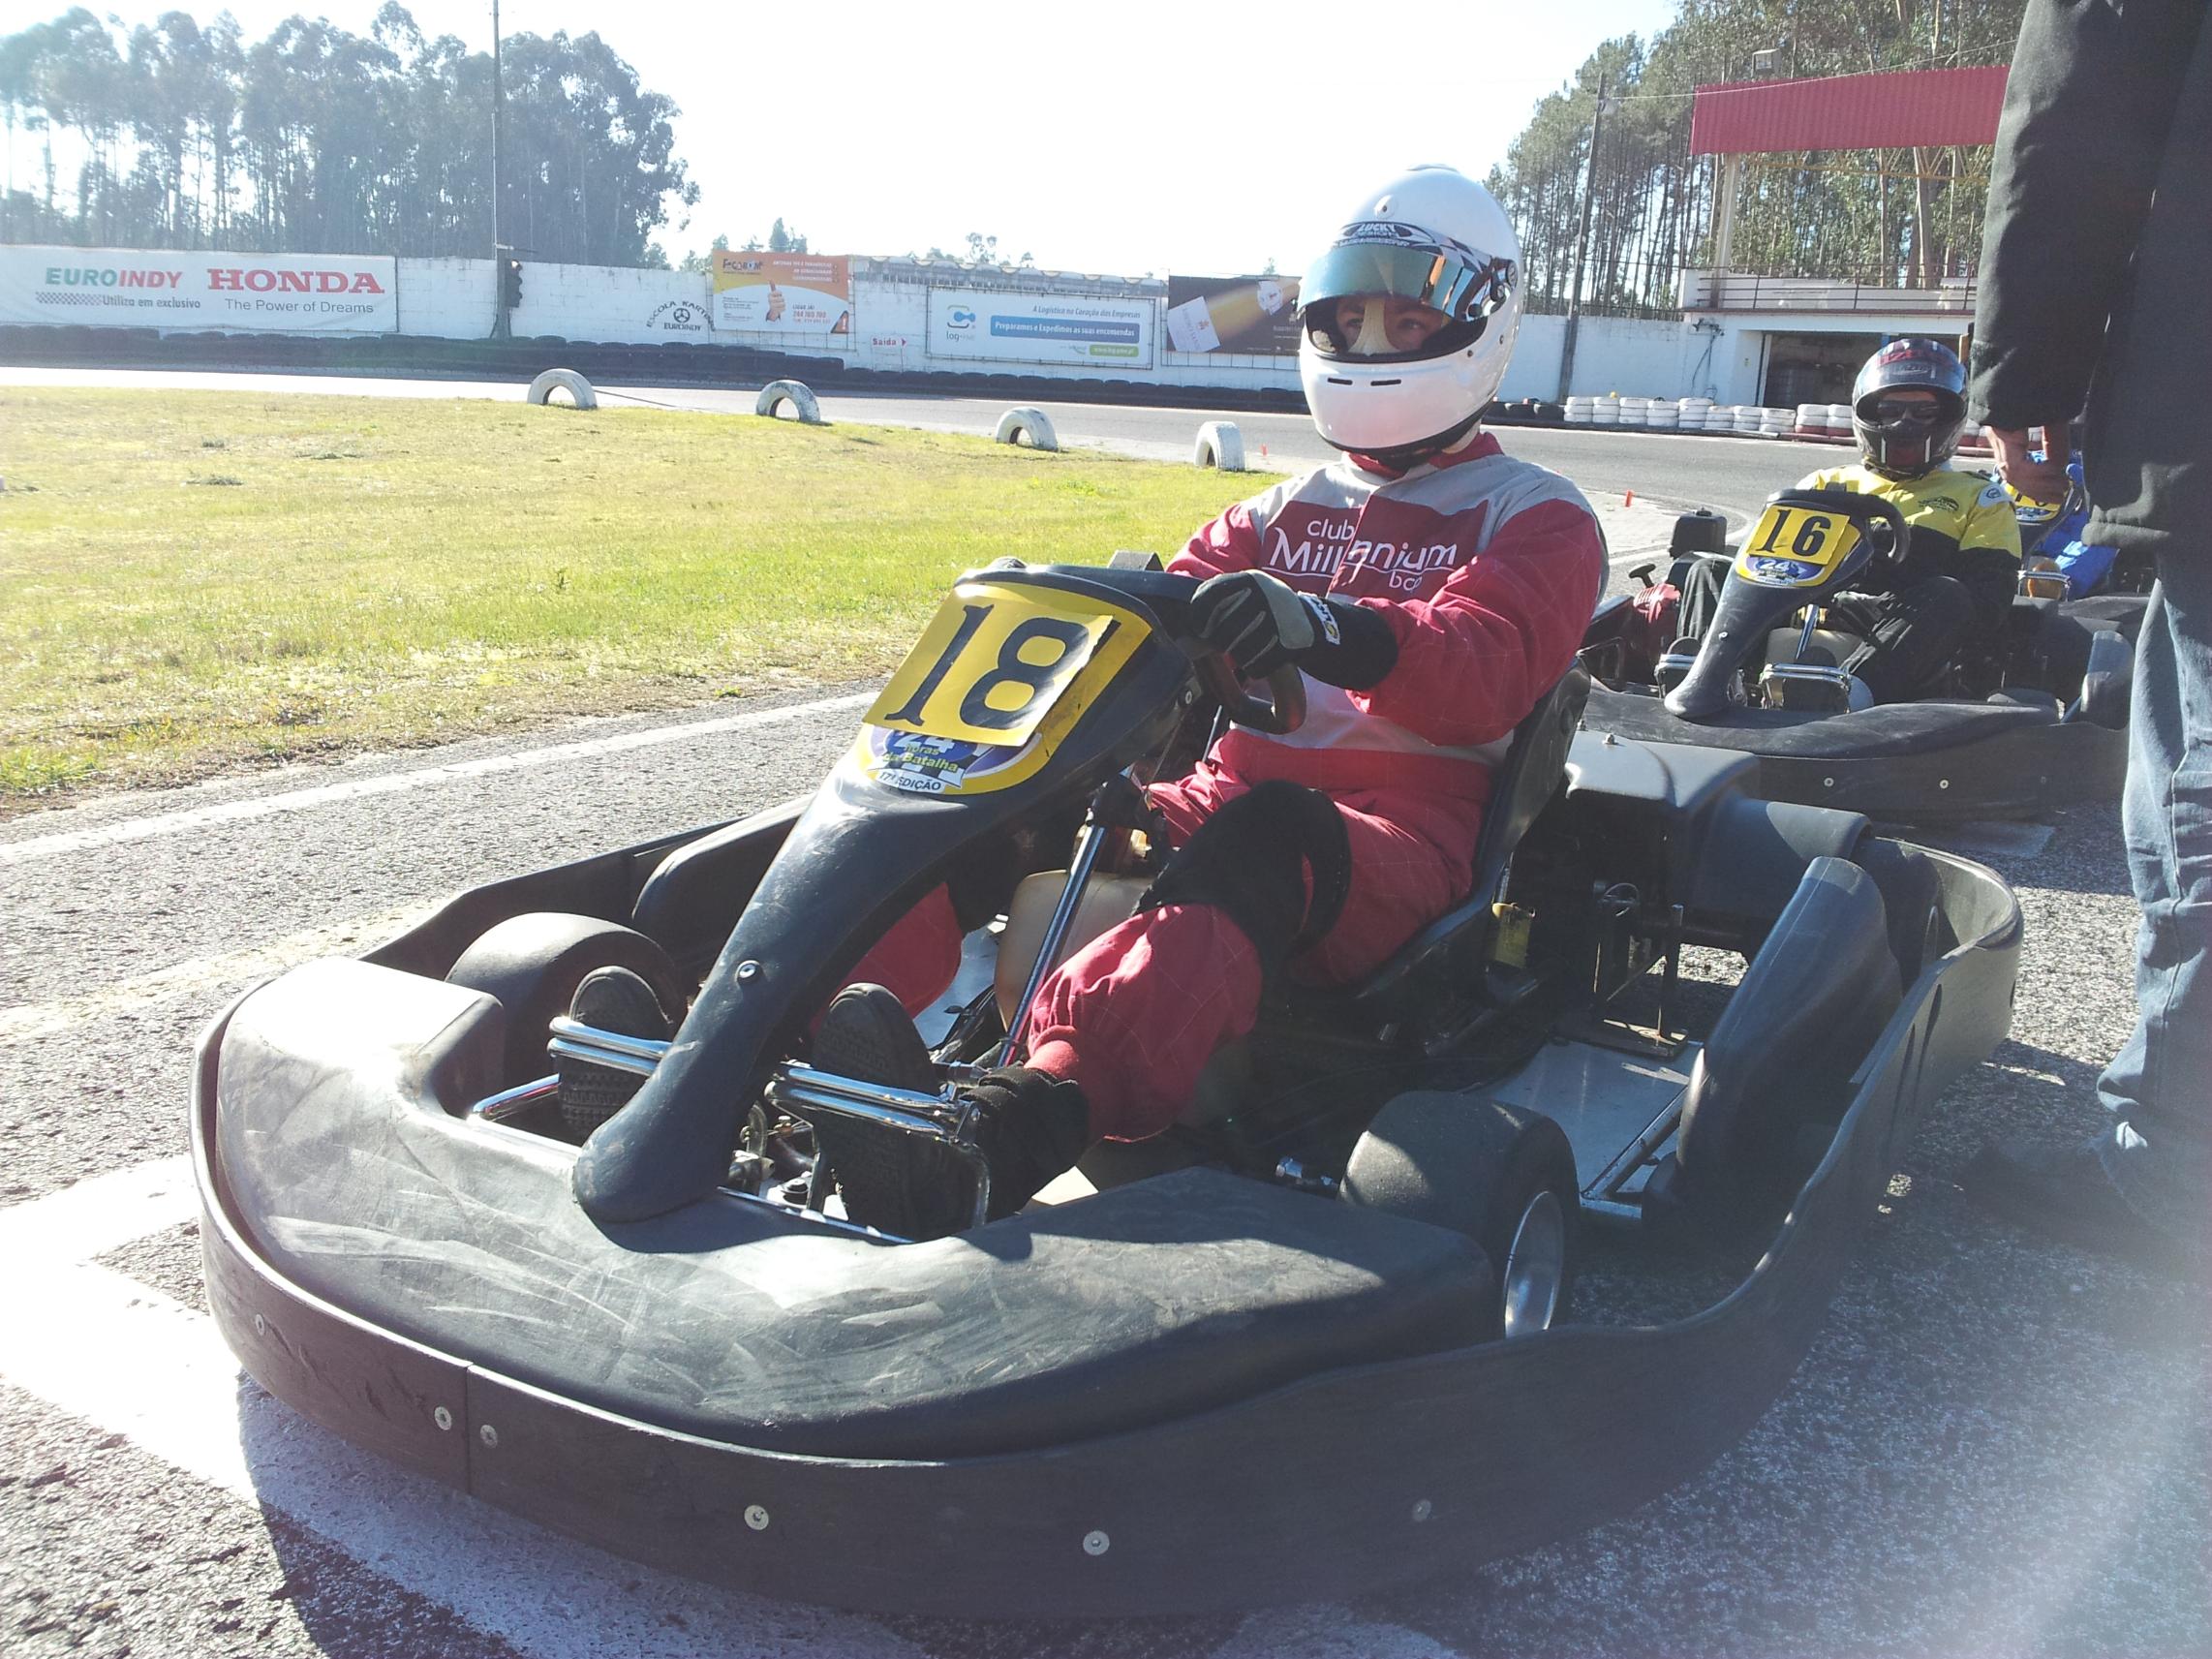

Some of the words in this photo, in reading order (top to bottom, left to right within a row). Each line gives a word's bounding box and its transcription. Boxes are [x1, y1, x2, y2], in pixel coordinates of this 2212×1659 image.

[46, 267, 184, 289] EUROINDY
[206, 268, 385, 294] HONDA
[103, 294, 136, 307] Utiliza
[138, 298, 154, 308] em
[157, 296, 201, 309] exclusivo
[225, 298, 252, 310] The
[256, 300, 299, 312] Power
[303, 301, 317, 312] of
[321, 302, 375, 314] Dreams
[646, 300, 677, 327] ESCOLA
[663, 322, 702, 331] EUROINDY
[1306, 518, 1355, 540] club
[1755, 508, 1832, 557] 16
[1270, 526, 1459, 573] Millnnium
[884, 603, 1091, 730] 18
[905, 743, 941, 756] horas
[882, 752, 900, 762] da
[901, 751, 959, 773] Batalha
[897, 776, 942, 791] EDIÇÃO
